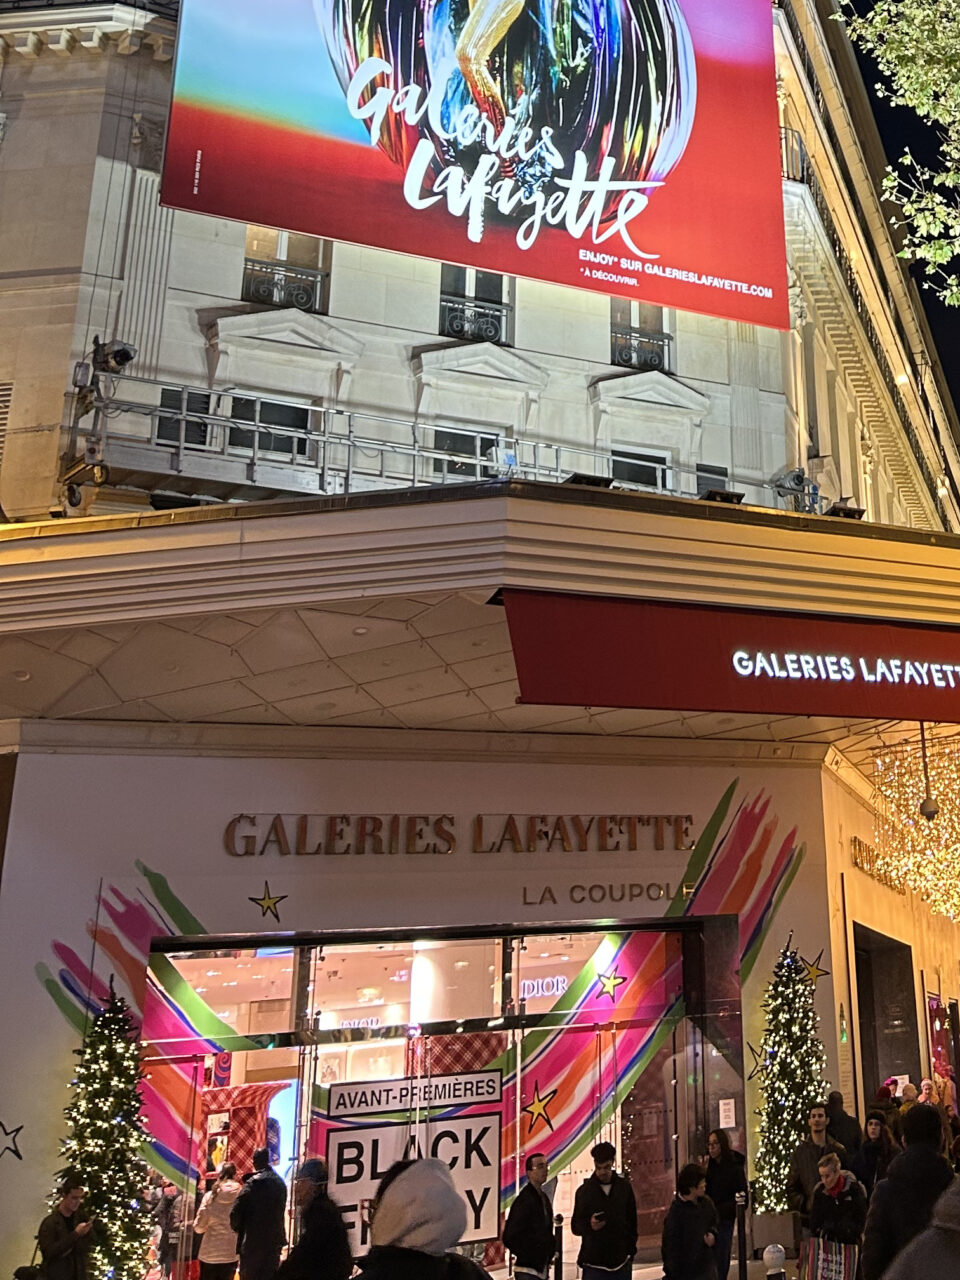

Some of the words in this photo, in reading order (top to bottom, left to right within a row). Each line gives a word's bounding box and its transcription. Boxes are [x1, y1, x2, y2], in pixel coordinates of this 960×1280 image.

[347, 56, 564, 169] Galeries
[403, 138, 665, 259] Lafayette
[620, 258, 642, 272] SUR
[644, 263, 773, 298] GALERIESLAFAYETTE.COM
[732, 650, 855, 681] GALERIES
[223, 814, 456, 857] GALERIES
[471, 813, 697, 855] LAFAYETTE
[523, 885, 557, 905] LA
[569, 882, 697, 904] COUPOLE
[521, 976, 568, 999] DIOR
[335, 1078, 496, 1110] AVANT-PREMIÈRES
